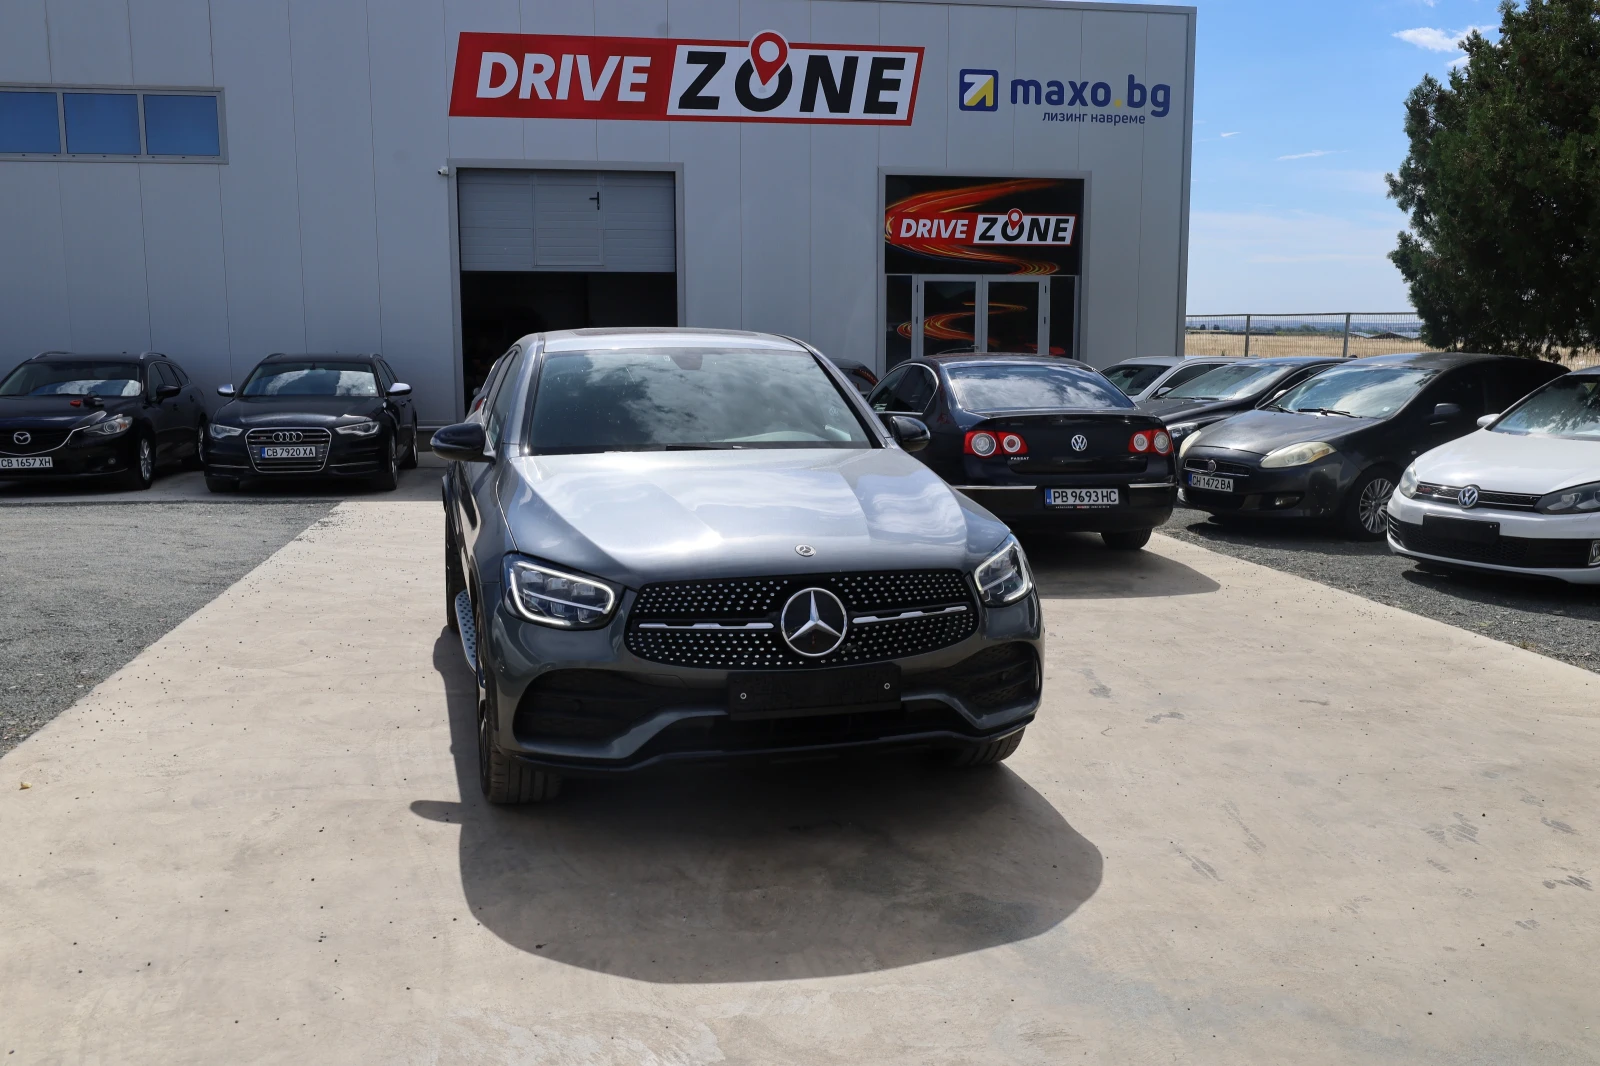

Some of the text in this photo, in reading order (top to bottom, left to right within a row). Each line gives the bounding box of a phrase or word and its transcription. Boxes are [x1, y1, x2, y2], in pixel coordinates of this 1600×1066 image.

[476, 50, 906, 115] DRIVE ZONE
[1010, 73, 1171, 118] maxo.bg
[1042, 111, 1146, 126] лизинг навреме
[899, 216, 1070, 243] DRIVE ZONE
[266, 447, 314, 457] CB 7920 XA
[1, 457, 51, 468] CB 1657 XH
[1192, 475, 1232, 491] CH 1472 BA
[1053, 490, 1117, 503] PB 9693 HC
